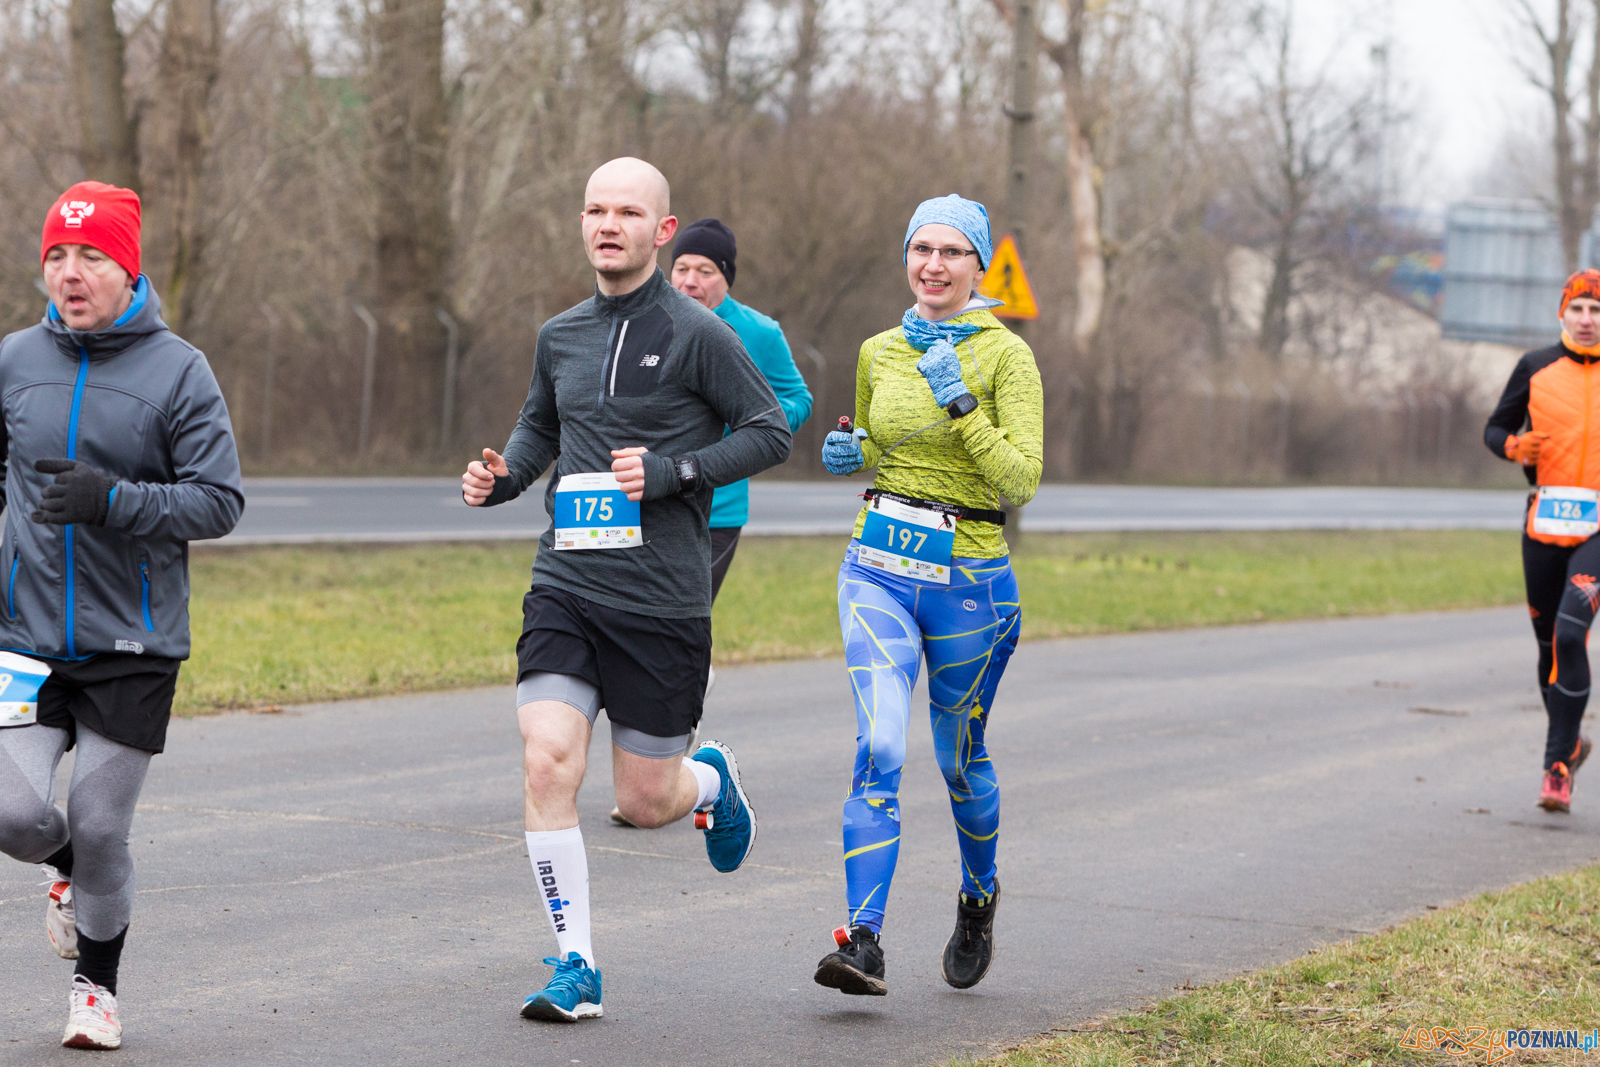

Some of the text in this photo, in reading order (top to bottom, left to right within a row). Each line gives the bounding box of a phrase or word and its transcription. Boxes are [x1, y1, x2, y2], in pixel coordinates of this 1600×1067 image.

[573, 497, 613, 521] 175
[1553, 501, 1582, 519] 126
[886, 524, 928, 554] 197
[537, 860, 568, 933] IRONMAN
